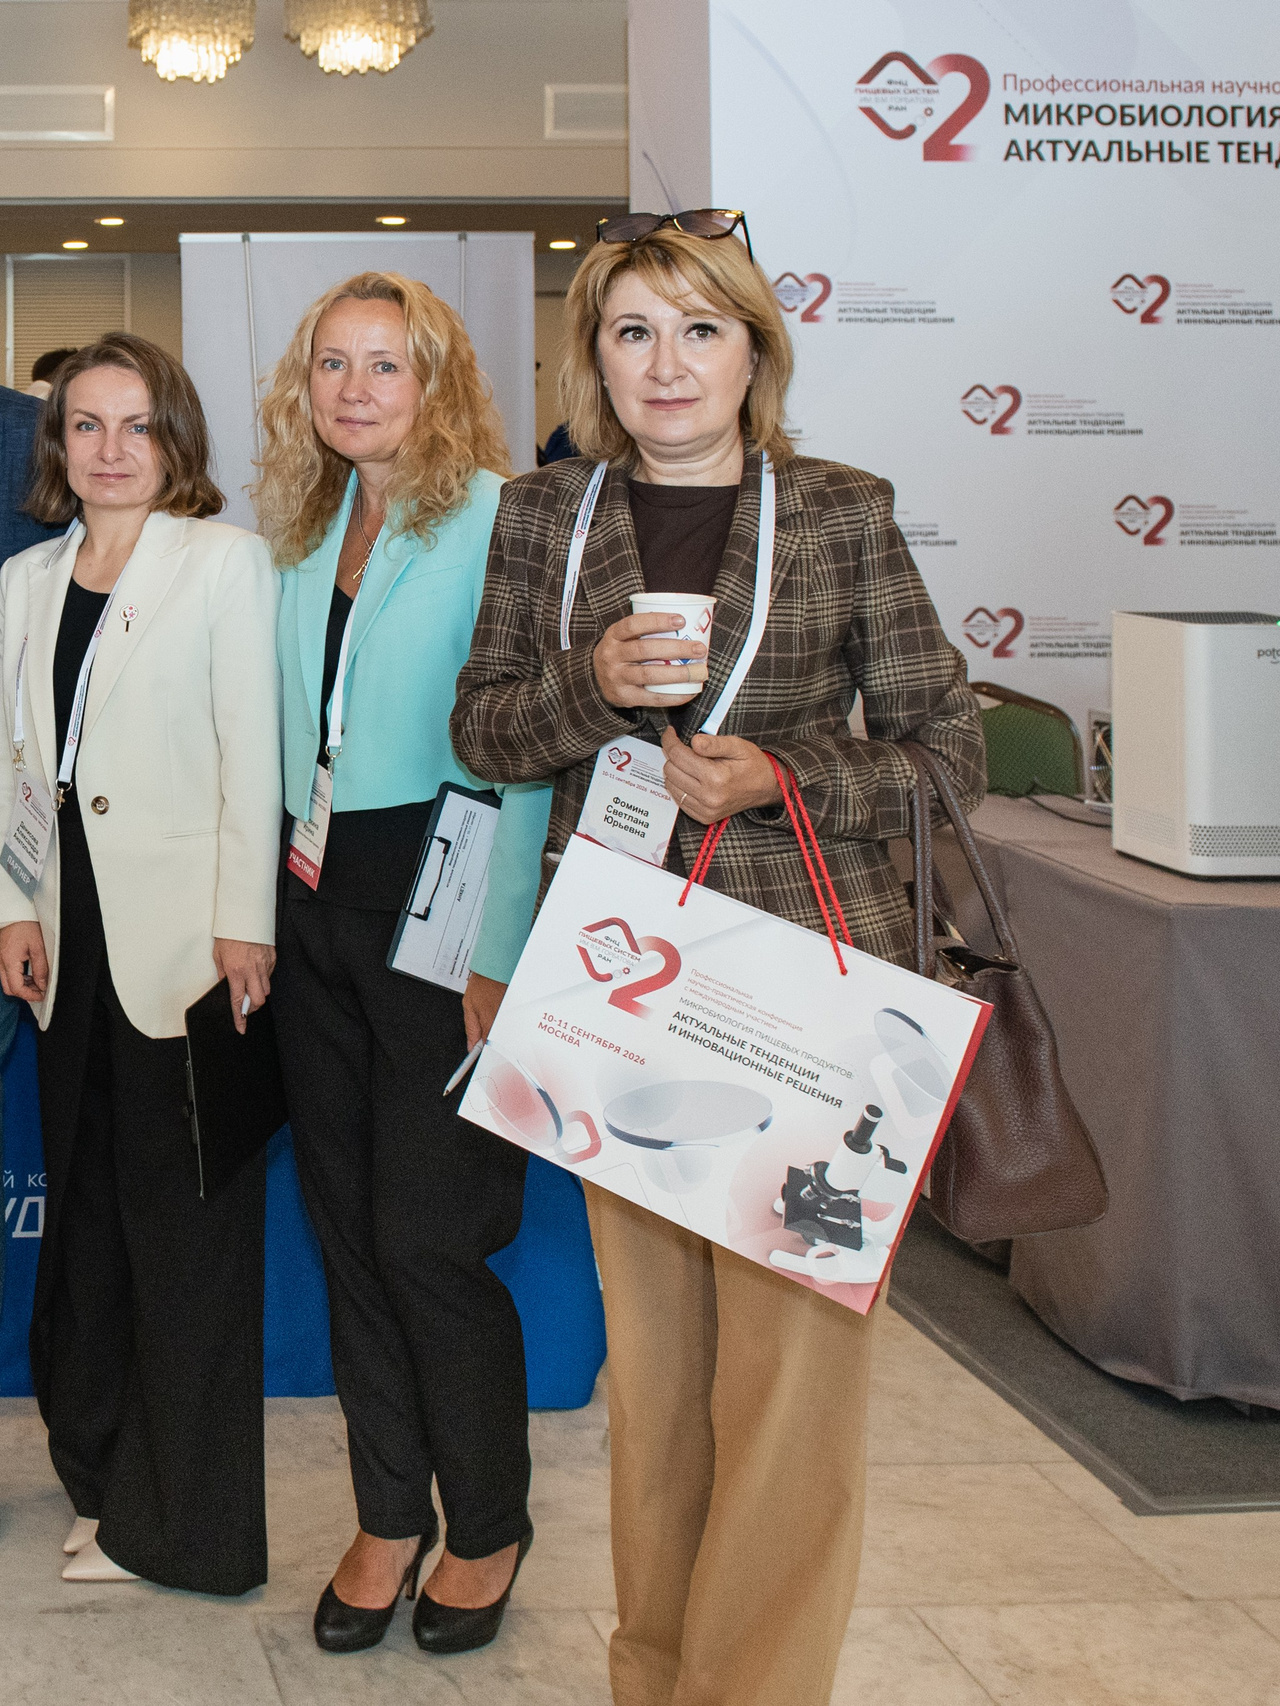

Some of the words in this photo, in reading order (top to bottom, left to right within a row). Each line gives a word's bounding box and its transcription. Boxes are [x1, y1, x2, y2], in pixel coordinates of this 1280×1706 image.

[1002, 74, 1205, 95] Профессиональная
[1004, 103, 1280, 128] МИКРОБИОЛОГИЯ
[1003, 139, 1210, 163] АКТУАЛЬНЫЕ
[1217, 140, 1280, 169] ТЕН
[602, 770, 615, 780] 10-11
[615, 775, 636, 788] сентября
[650, 789, 672, 802] МОСКВА
[606, 804, 650, 829] Светлана
[612, 796, 649, 818] Фомина
[603, 814, 646, 838] Юрьевна
[7, 855, 31, 884] ПАРТНЕР
[289, 851, 315, 878] УЧАСТНИК
[456, 882, 466, 902] АНКЕТА
[578, 931, 612, 949] ПИЩЕВЫХ
[614, 948, 640, 962] СИСТЕМ
[604, 936, 620, 947] ФНЦ
[597, 954, 611, 963] РАН
[601, 947, 634, 966] ГОРБАТОВА
[691, 968, 754, 1000] Профессиональная
[688, 978, 756, 1012] научно-практическая
[757, 1008, 803, 1032] конференция
[689, 988, 745, 1015] международным
[746, 1012, 778, 1030] участием
[537, 1022, 580, 1047] МОСКВА
[542, 1012, 568, 1029] 10-11
[570, 1025, 621, 1054] СЕНТЯБРЯ
[622, 1050, 645, 1065] 2026
[672, 1011, 748, 1050] АКТУАЛЬНЫЕ
[750, 1044, 820, 1083] ТЕНДЕНЦИИ
[679, 997, 754, 1035] МИКРОБИОЛОГИЯ
[755, 1031, 801, 1056] ПИЩЕВЫХ
[800, 1051, 854, 1080] ПРОДУКТОВ:
[668, 1023, 677, 1033] И
[678, 1028, 785, 1083] ИННОВАЦИОННЫЕ
[785, 1077, 843, 1109] РЕШЕНИЯ
